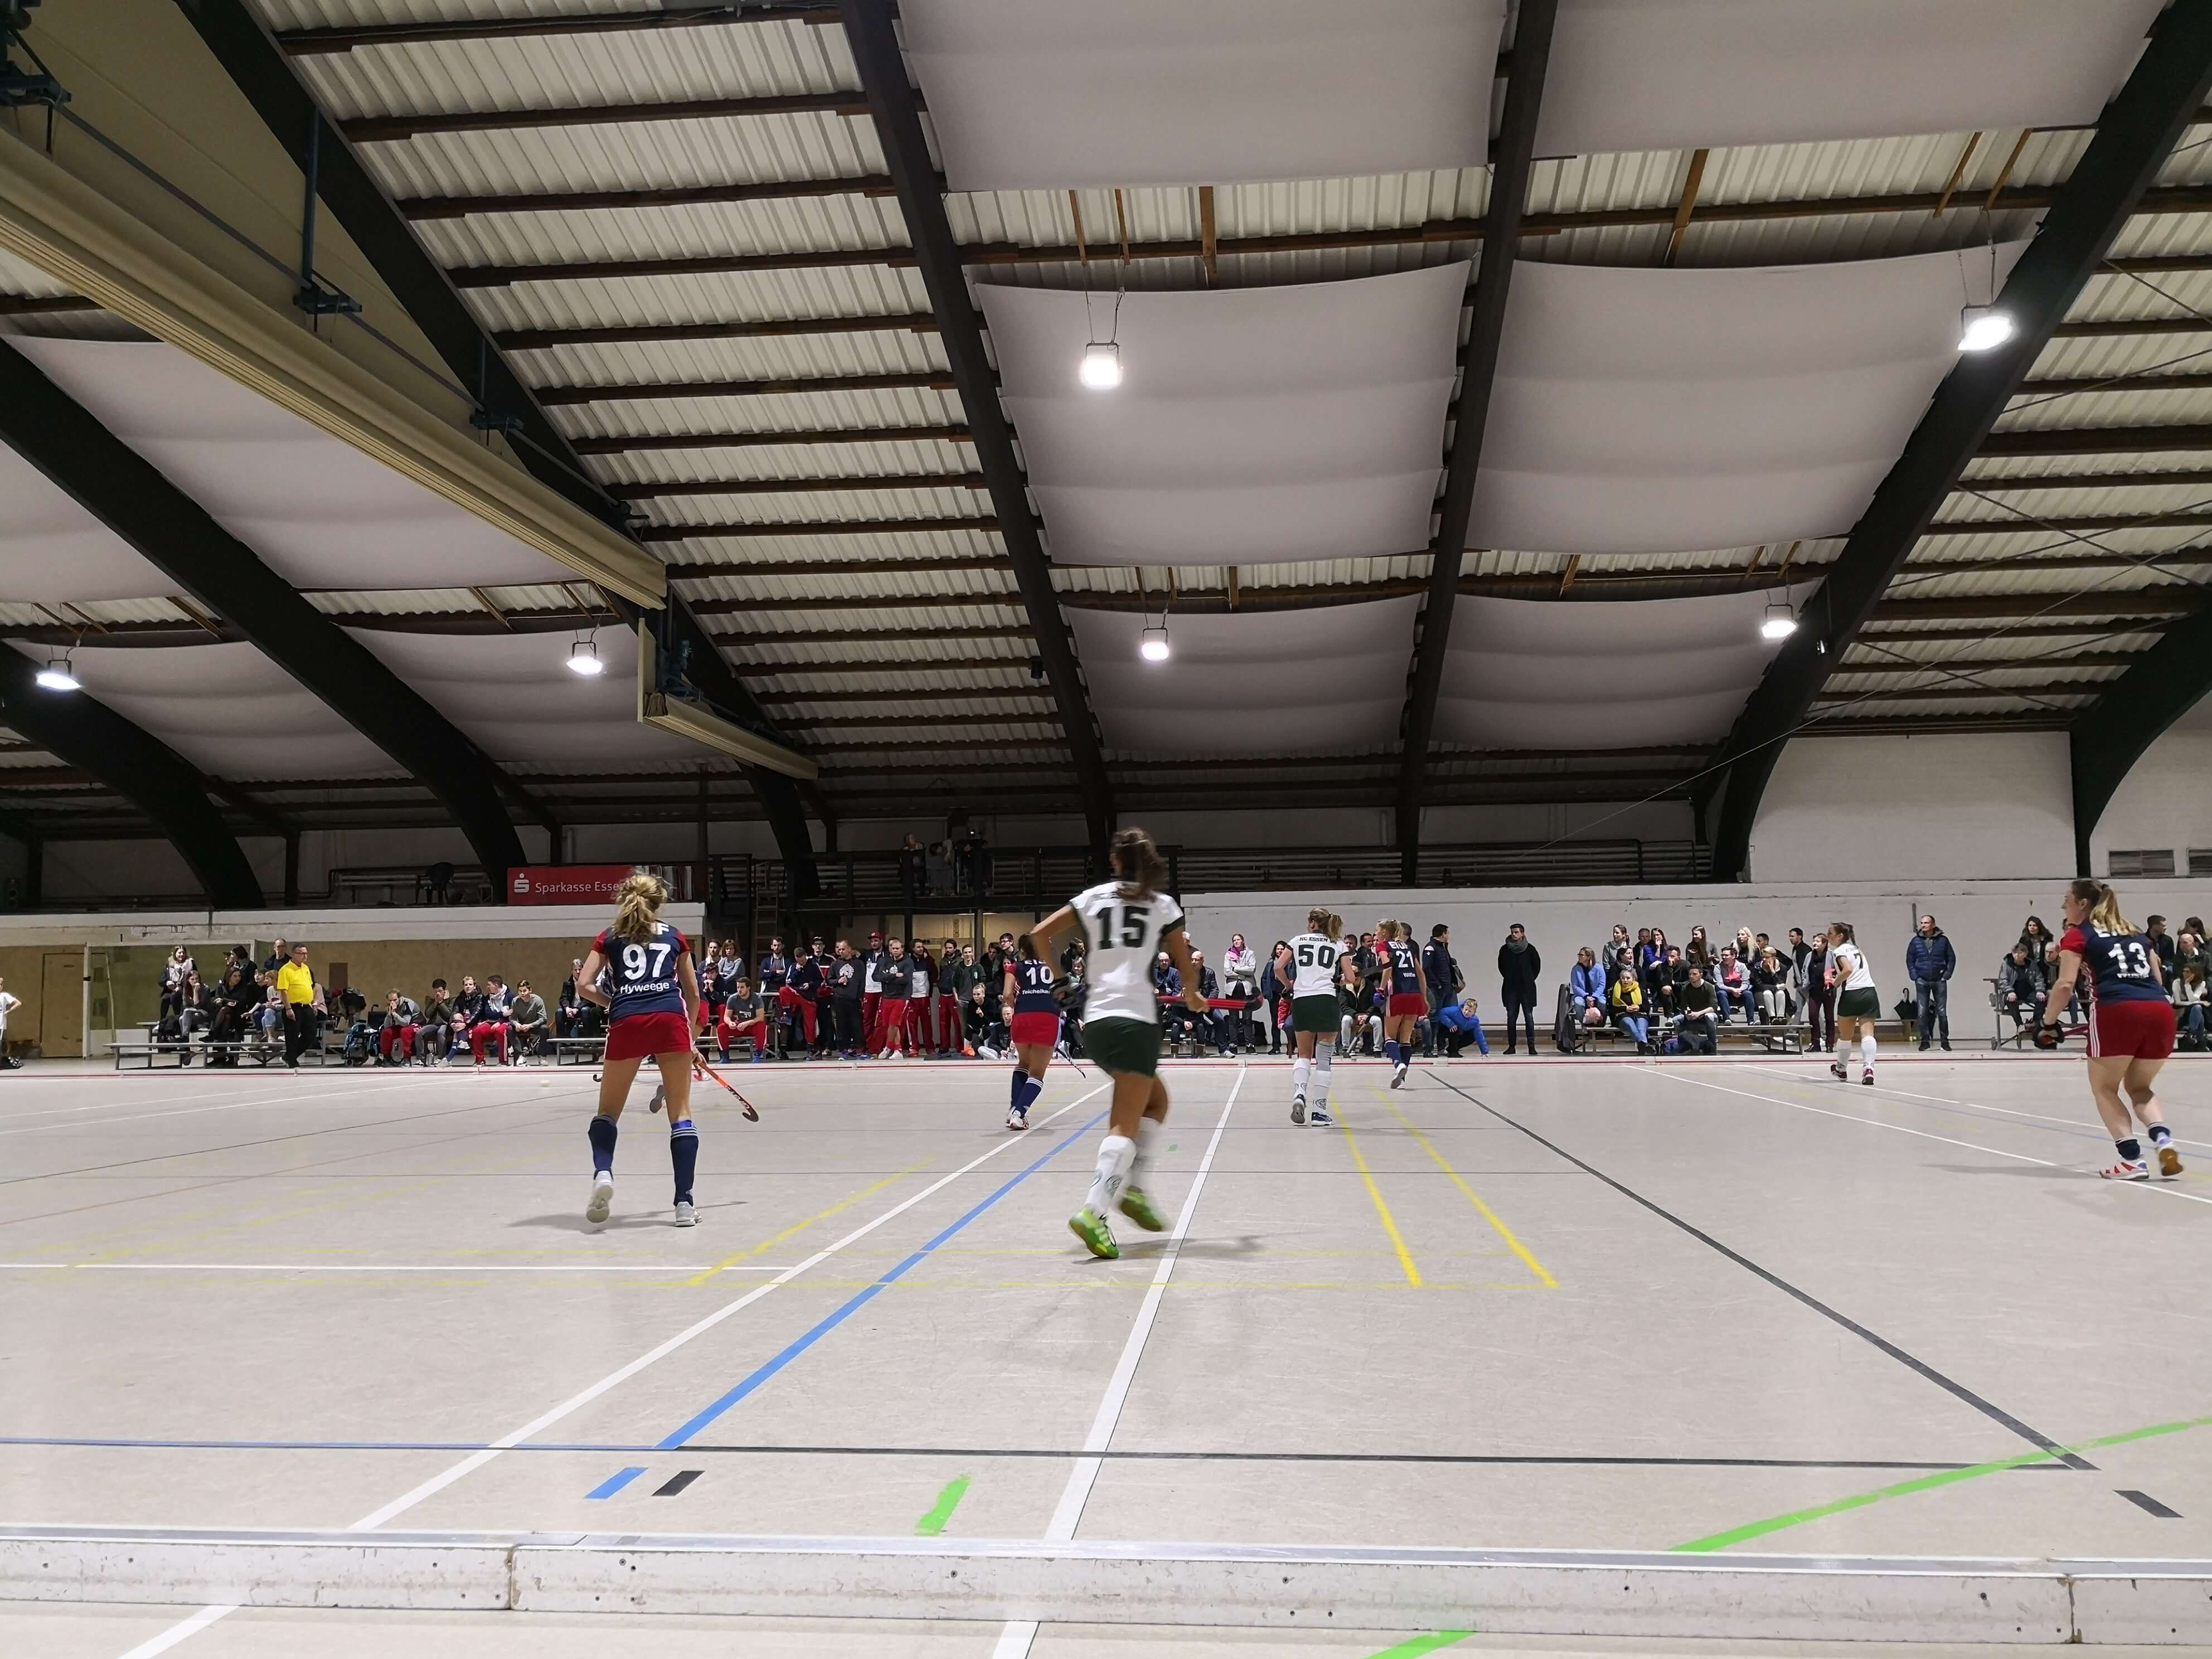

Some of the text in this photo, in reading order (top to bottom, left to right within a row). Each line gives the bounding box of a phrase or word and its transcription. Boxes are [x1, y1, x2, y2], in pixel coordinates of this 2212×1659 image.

[535, 882, 591, 894] Sparkasse
[1096, 906, 1149, 950] 15
[623, 943, 671, 980] 97
[1298, 944, 1335, 969] 50
[1396, 950, 1414, 968] 21
[1854, 953, 1863, 969] 7
[2108, 942, 2150, 975] 13
[1026, 966, 1054, 985] 10
[620, 982, 670, 994] Hyweege
